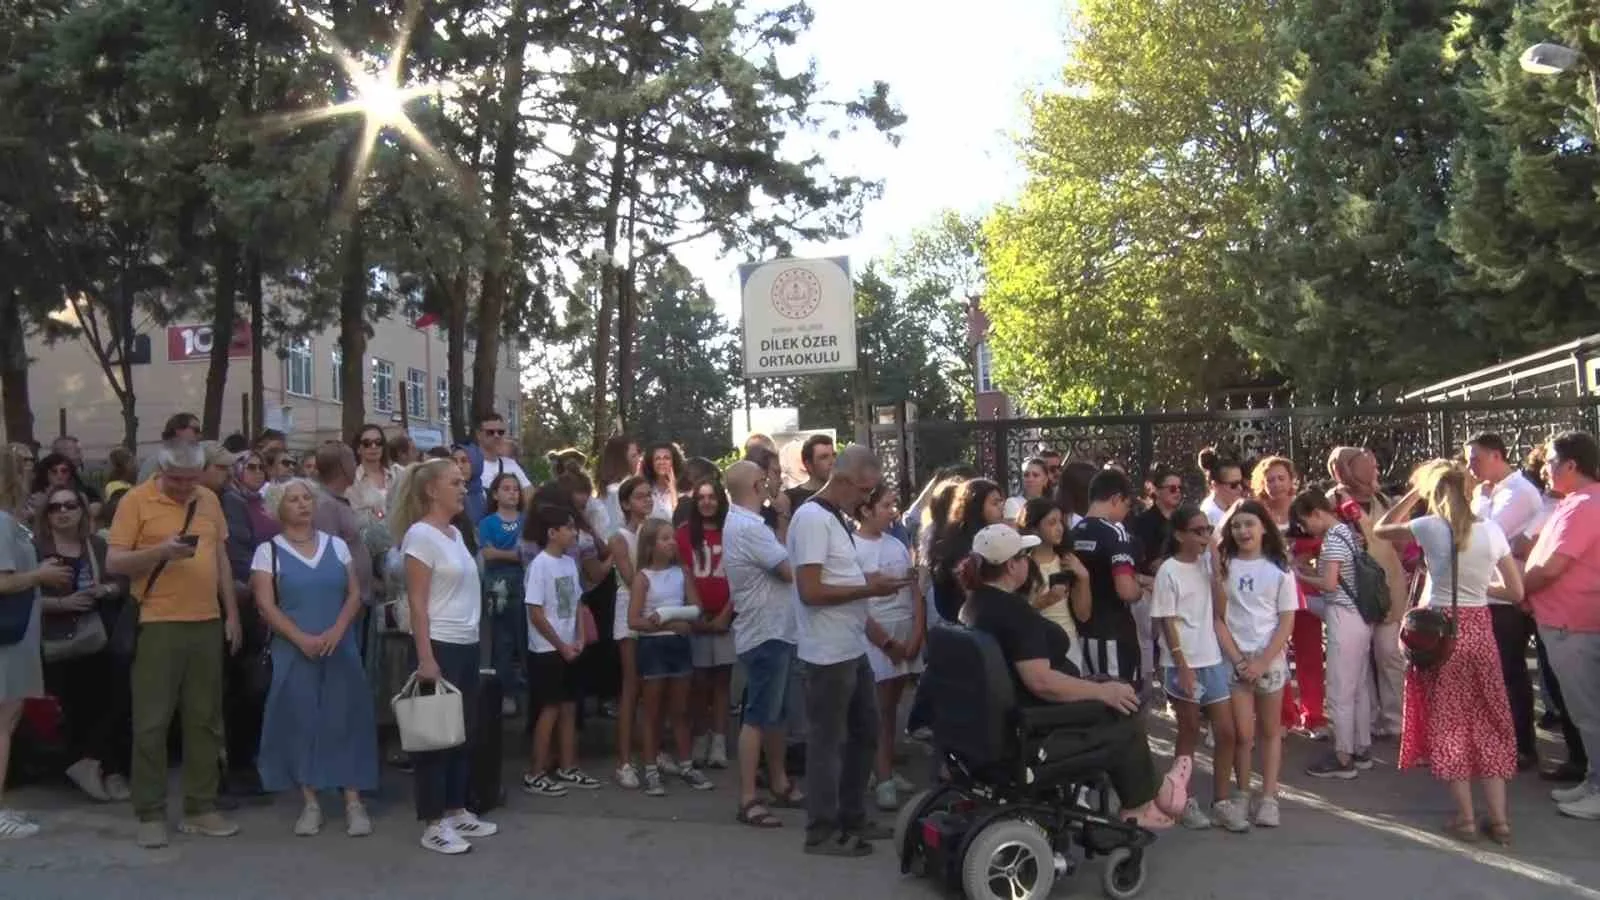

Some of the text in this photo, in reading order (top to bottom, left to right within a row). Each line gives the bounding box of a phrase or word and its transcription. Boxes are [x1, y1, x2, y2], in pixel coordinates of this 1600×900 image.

[761, 334, 837, 352] DİLEK ÖZER
[759, 351, 840, 367] ORTAOKULU
